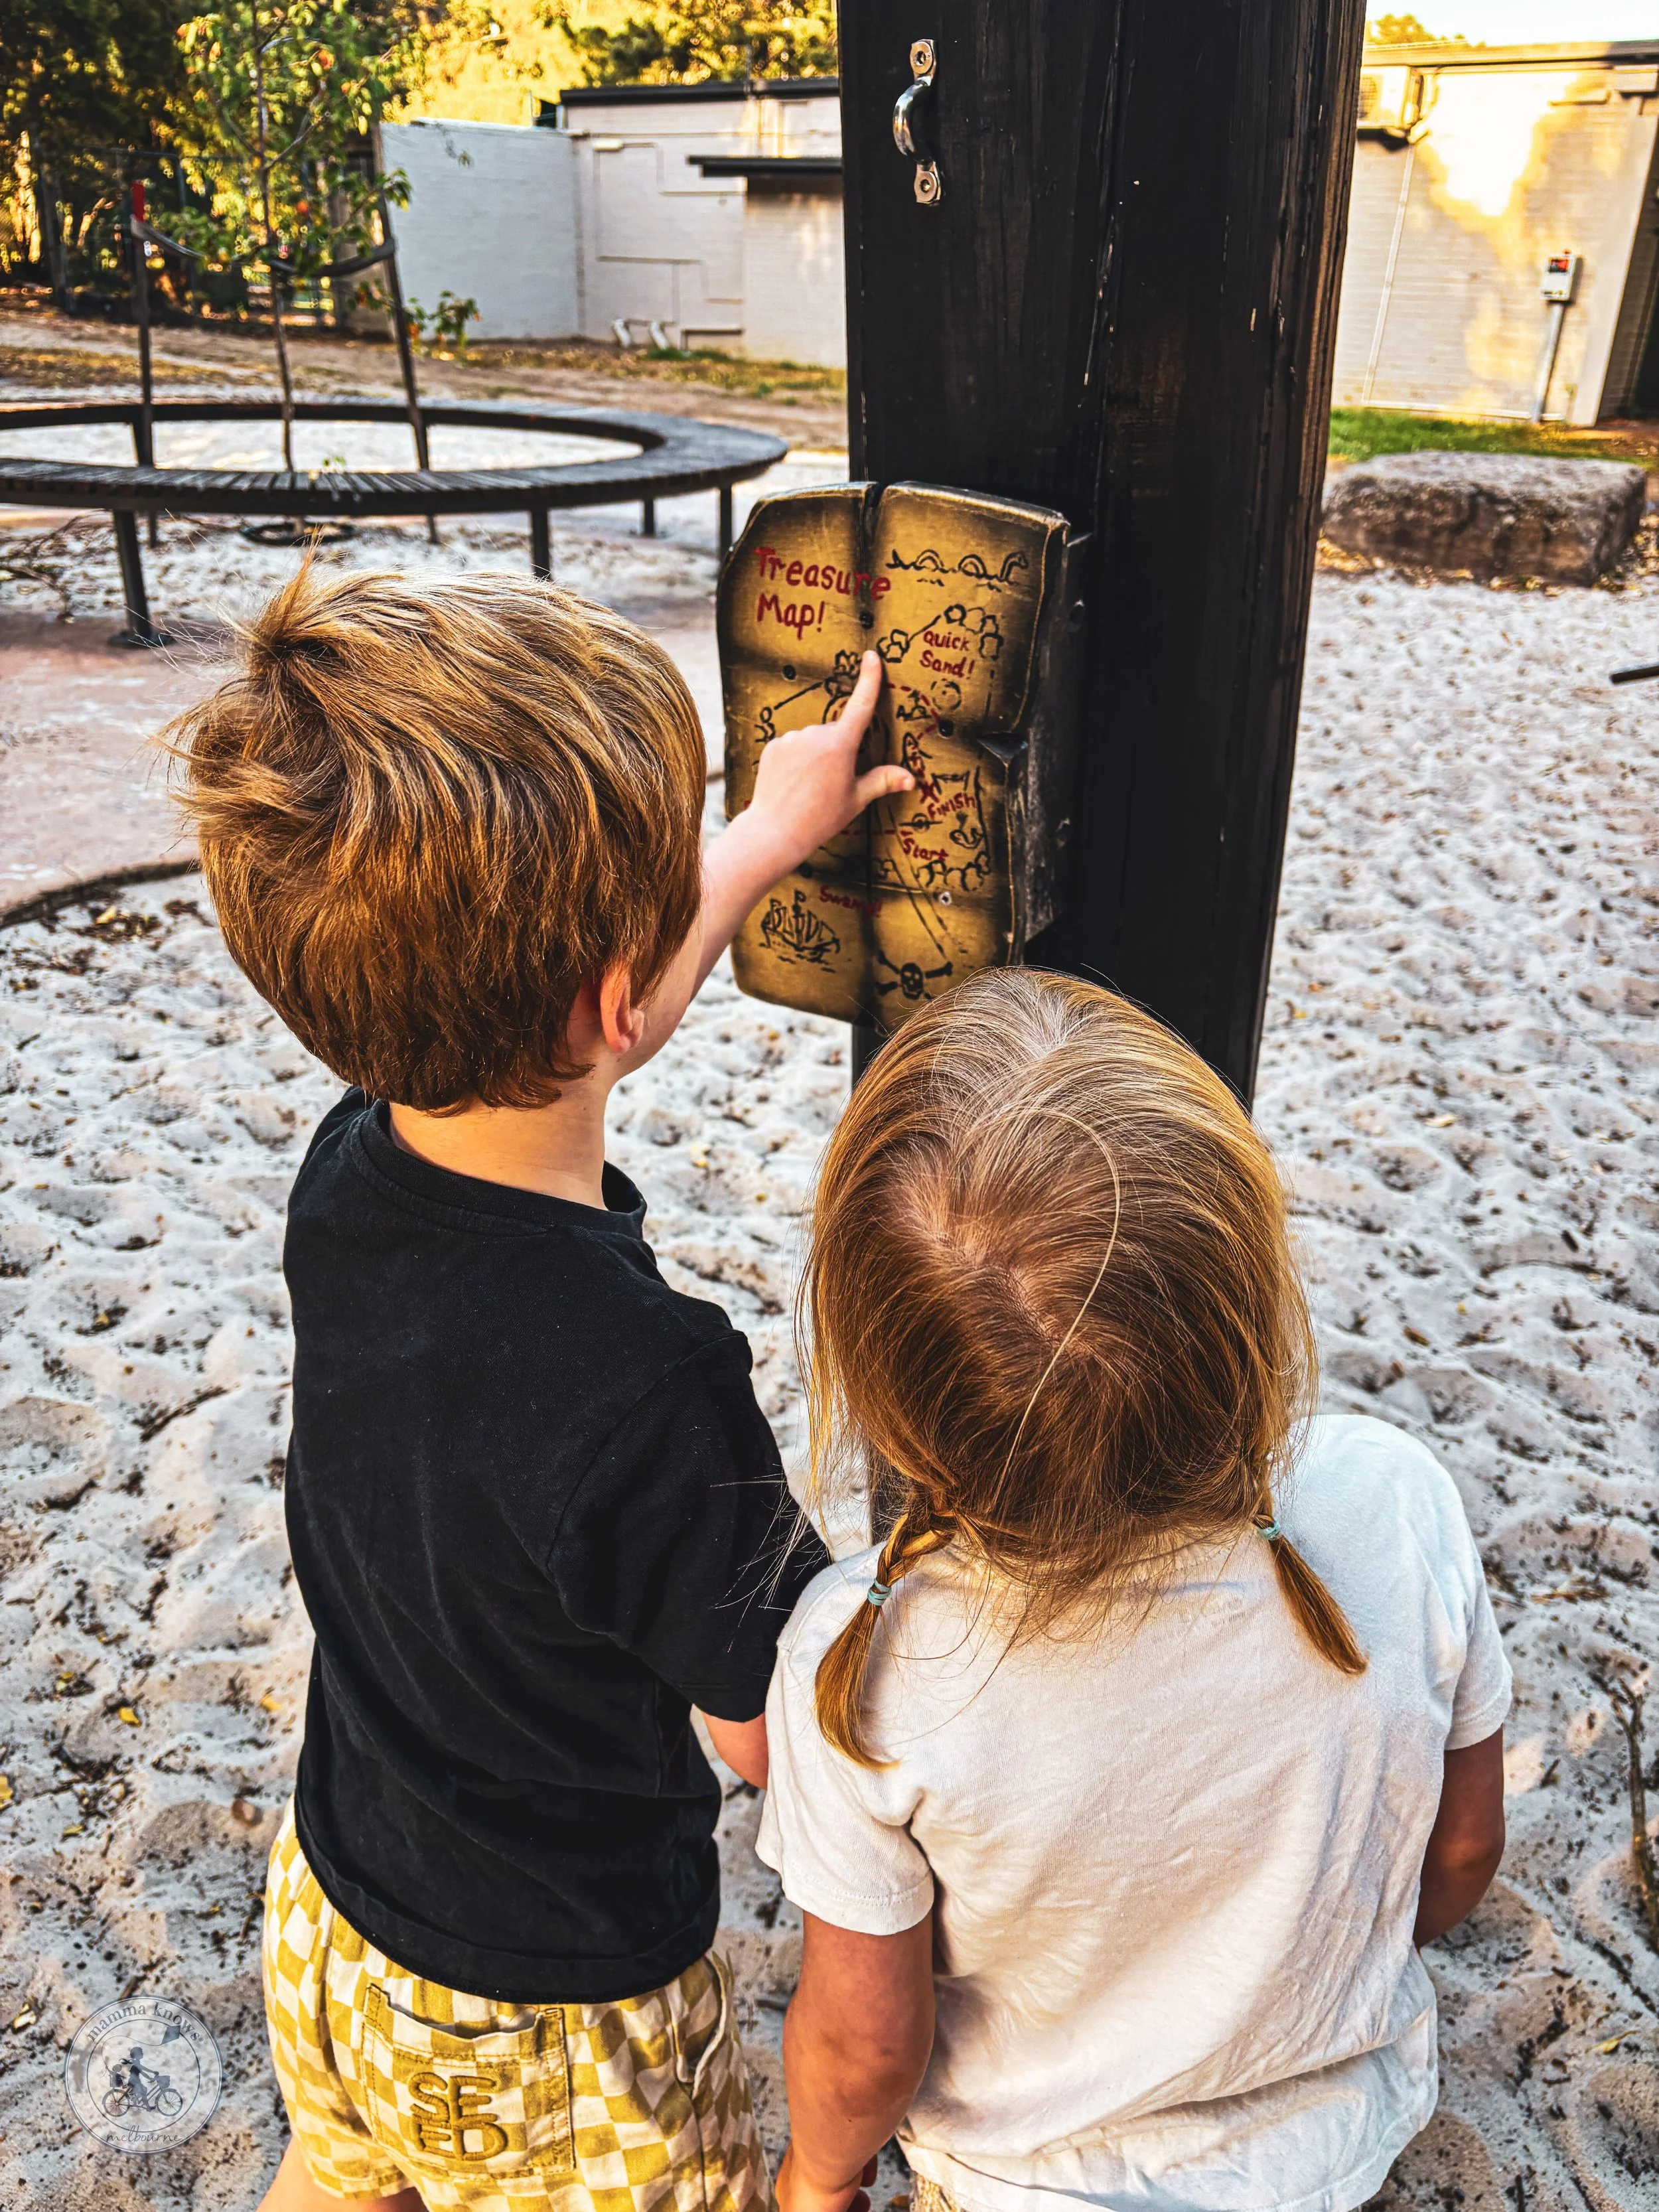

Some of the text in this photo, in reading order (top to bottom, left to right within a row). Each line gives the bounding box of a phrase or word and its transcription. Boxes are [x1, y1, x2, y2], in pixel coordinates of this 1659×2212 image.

[755, 547, 892, 601] Treasure
[757, 593, 827, 640] Map!
[923, 630, 970, 651] Quick
[919, 649, 975, 680] Sand!
[902, 838, 949, 863] Start
